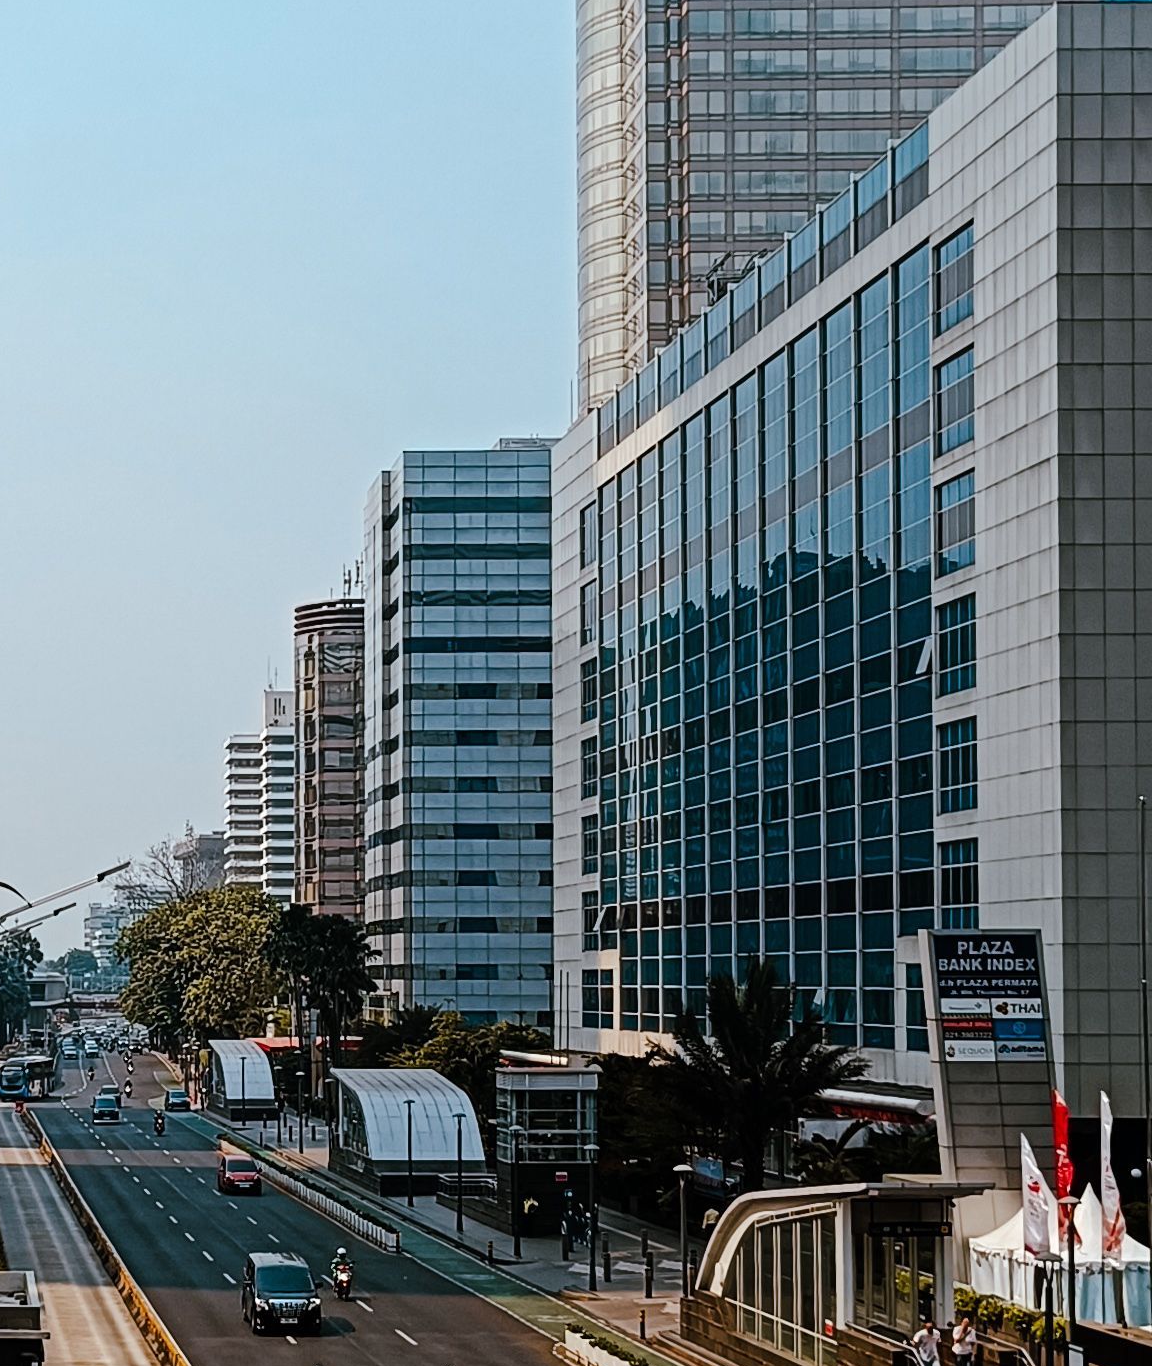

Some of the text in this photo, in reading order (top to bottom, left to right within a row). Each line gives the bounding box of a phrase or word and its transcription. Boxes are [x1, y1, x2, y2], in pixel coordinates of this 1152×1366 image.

[957, 941, 1014, 954] PLAZA
[938, 958, 1036, 971] BANK INDEX
[956, 979, 989, 987] PLAZA
[991, 979, 1039, 987] PERMATA
[1010, 1003, 1041, 1013] THAI
